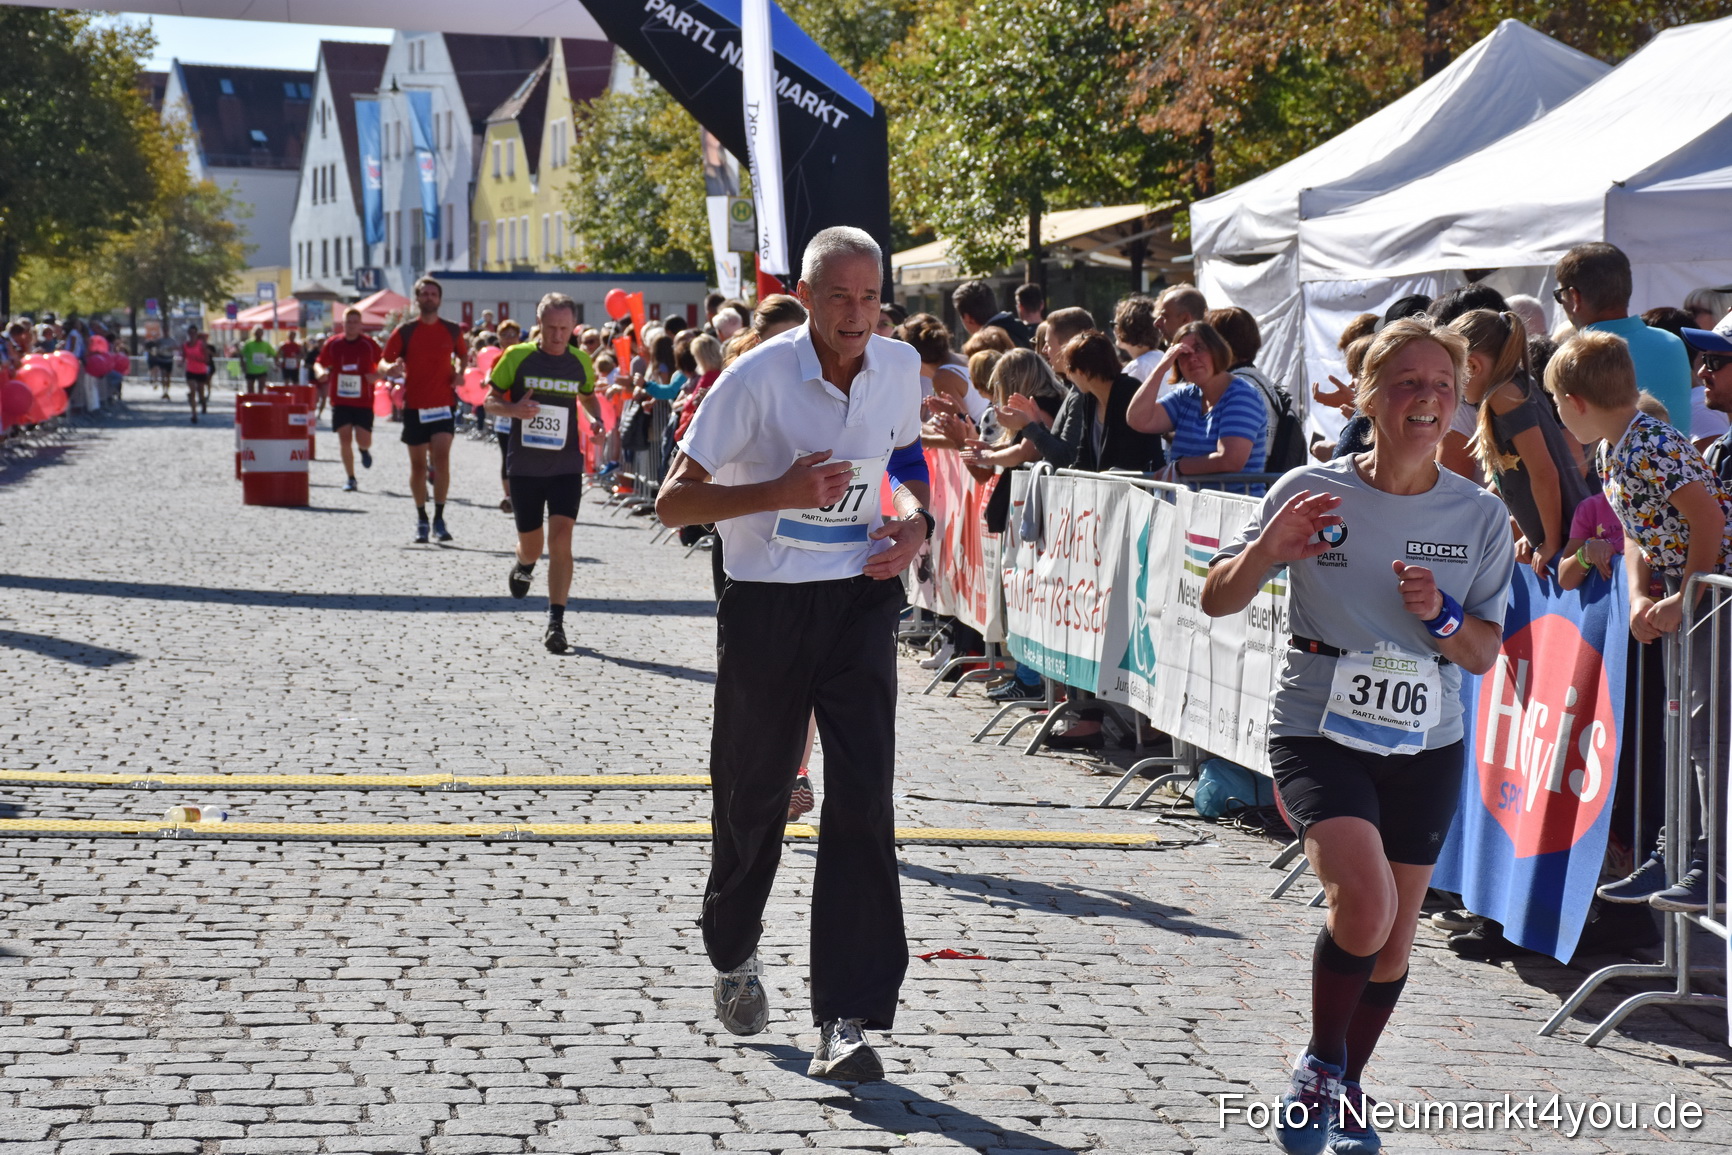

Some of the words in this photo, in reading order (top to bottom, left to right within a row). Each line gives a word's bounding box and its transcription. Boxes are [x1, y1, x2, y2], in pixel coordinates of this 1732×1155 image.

[644, 0, 716, 53] PARTL
[720, 41, 849, 129] NMARKT
[524, 377, 579, 393] BOCK
[528, 417, 561, 431] 2533
[801, 513, 823, 522] PARTL
[1317, 552, 1348, 561] PARTL
[1407, 541, 1468, 558] BOCK
[1372, 657, 1418, 672] BOCK
[1349, 674, 1428, 715] 3106
[1352, 709, 1376, 720] PARTL
[1378, 715, 1411, 727] Neumarkt
[1483, 653, 1607, 812] Hervis
